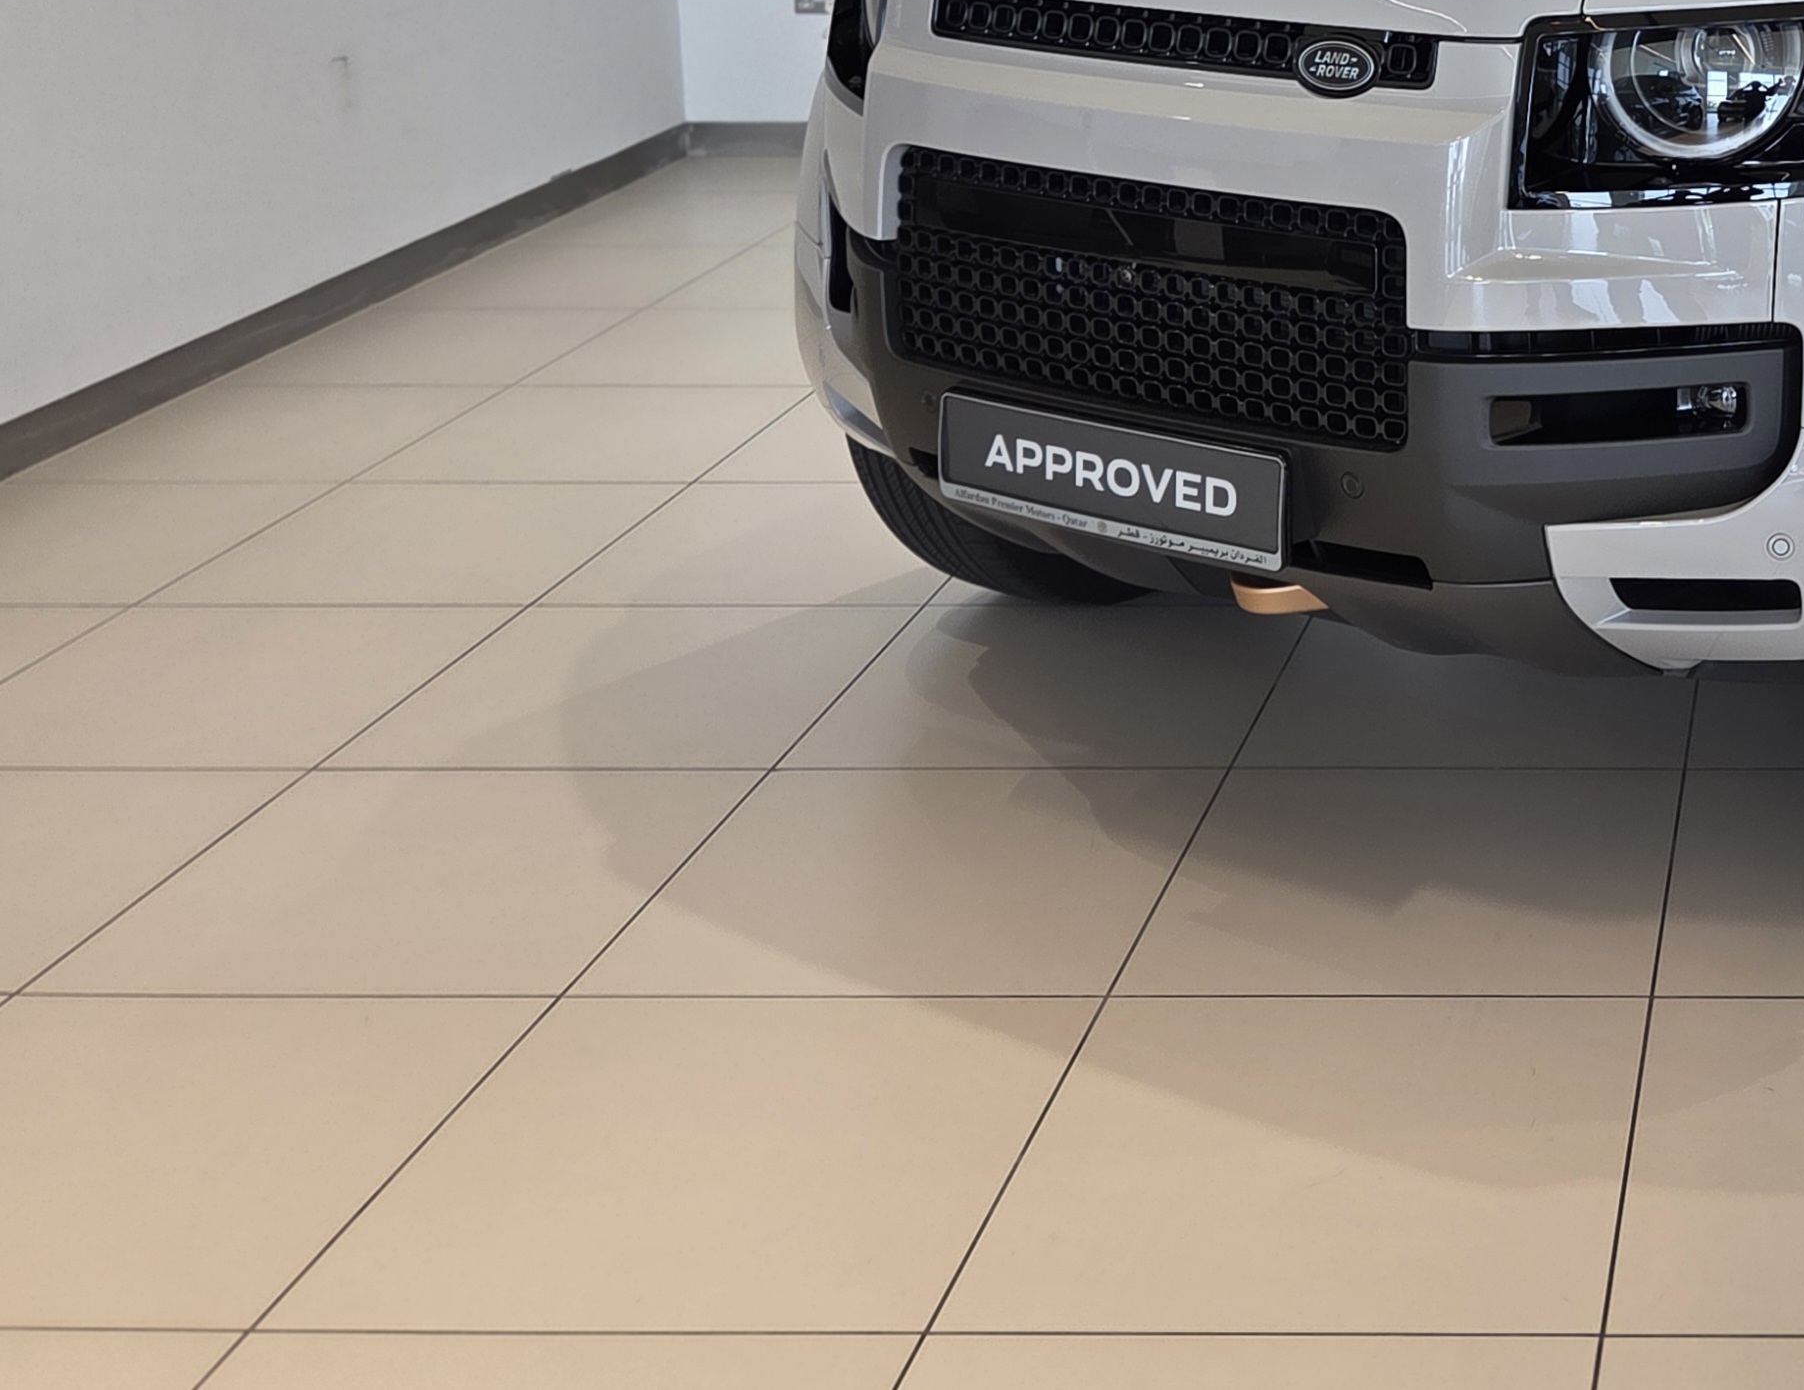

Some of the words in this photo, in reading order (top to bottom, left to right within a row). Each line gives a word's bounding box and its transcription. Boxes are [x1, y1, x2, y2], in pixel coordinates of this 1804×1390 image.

[1314, 50, 1350, 65] LAND
[1316, 64, 1359, 80] ROVER
[985, 434, 1237, 517] APPROVED
[992, 496, 1024, 513] Premier
[1062, 514, 1088, 528] Qatar
[1117, 527, 1140, 539] قطر
